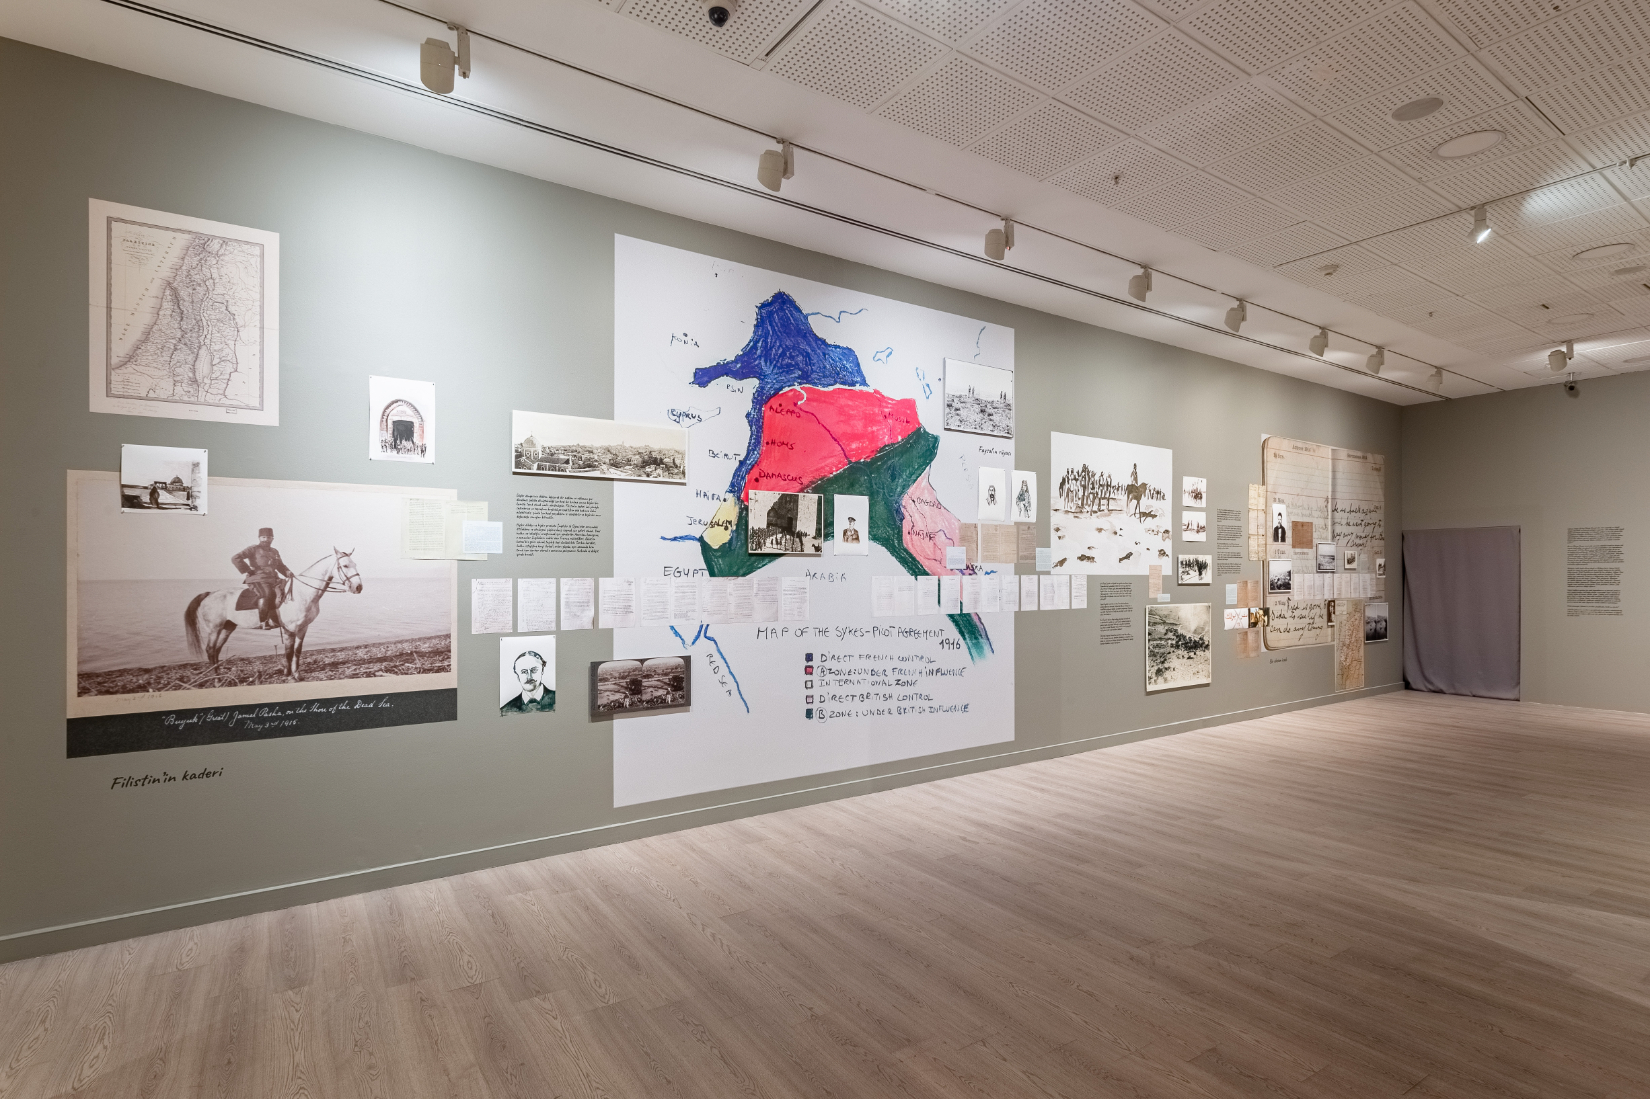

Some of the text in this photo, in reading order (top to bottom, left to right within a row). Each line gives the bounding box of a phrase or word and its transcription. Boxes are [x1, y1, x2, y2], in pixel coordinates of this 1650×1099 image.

[769, 405, 802, 418] ALEPPO
[771, 439, 795, 450] HOMS
[759, 469, 804, 485] DAMASCUS
[663, 566, 709, 578] EGYPT
[757, 627, 789, 639] MAP
[795, 627, 809, 637] OF
[813, 627, 830, 637] THE
[897, 627, 945, 640] AGREEMENT
[939, 638, 961, 650] 1916
[898, 655, 936, 663] CONTROL
[706, 653, 732, 697] RED SEA
[819, 679, 918, 687] INTERNATIONAL ZONE
[897, 693, 934, 701] CONTROL
[329, 704, 338, 714] of
[339, 701, 350, 710] the
[354, 699, 374, 709] Dead
[861, 708, 893, 717] UNDER
[928, 703, 969, 714] INFLUENCE
[244, 720, 263, 731] May
[111, 767, 224, 790] Filistin'in kaderi
